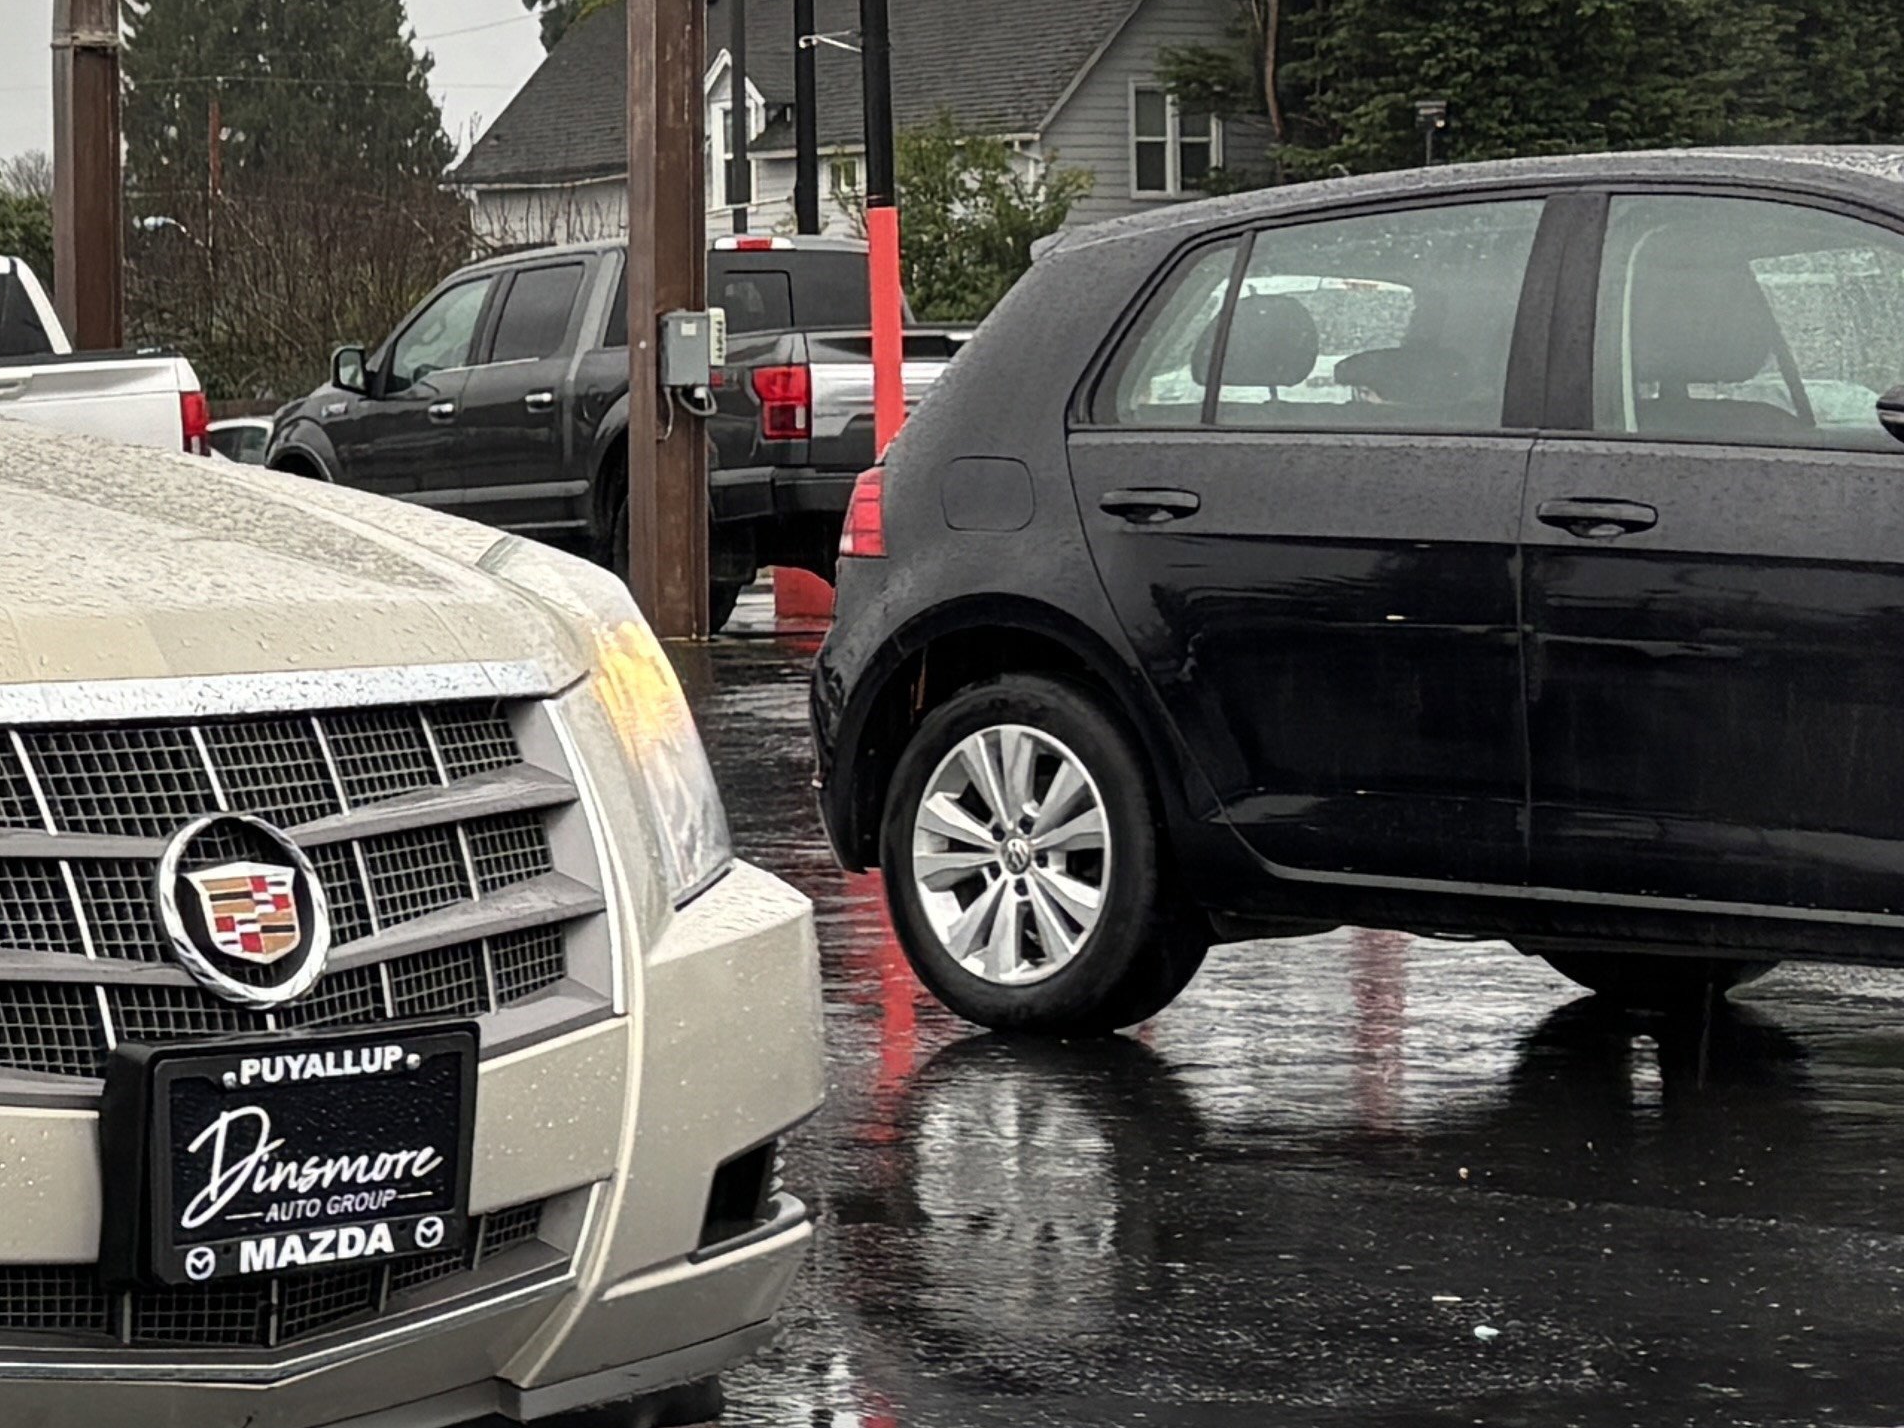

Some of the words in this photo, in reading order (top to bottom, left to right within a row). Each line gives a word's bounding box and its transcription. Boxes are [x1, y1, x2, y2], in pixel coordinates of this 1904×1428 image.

[240, 1046, 403, 1085] PUYALLUP
[181, 1106, 443, 1228] Dinsmore
[266, 1198, 321, 1222] AUTO
[327, 1189, 397, 1215] GROUP
[239, 1223, 395, 1274] MAZDA
